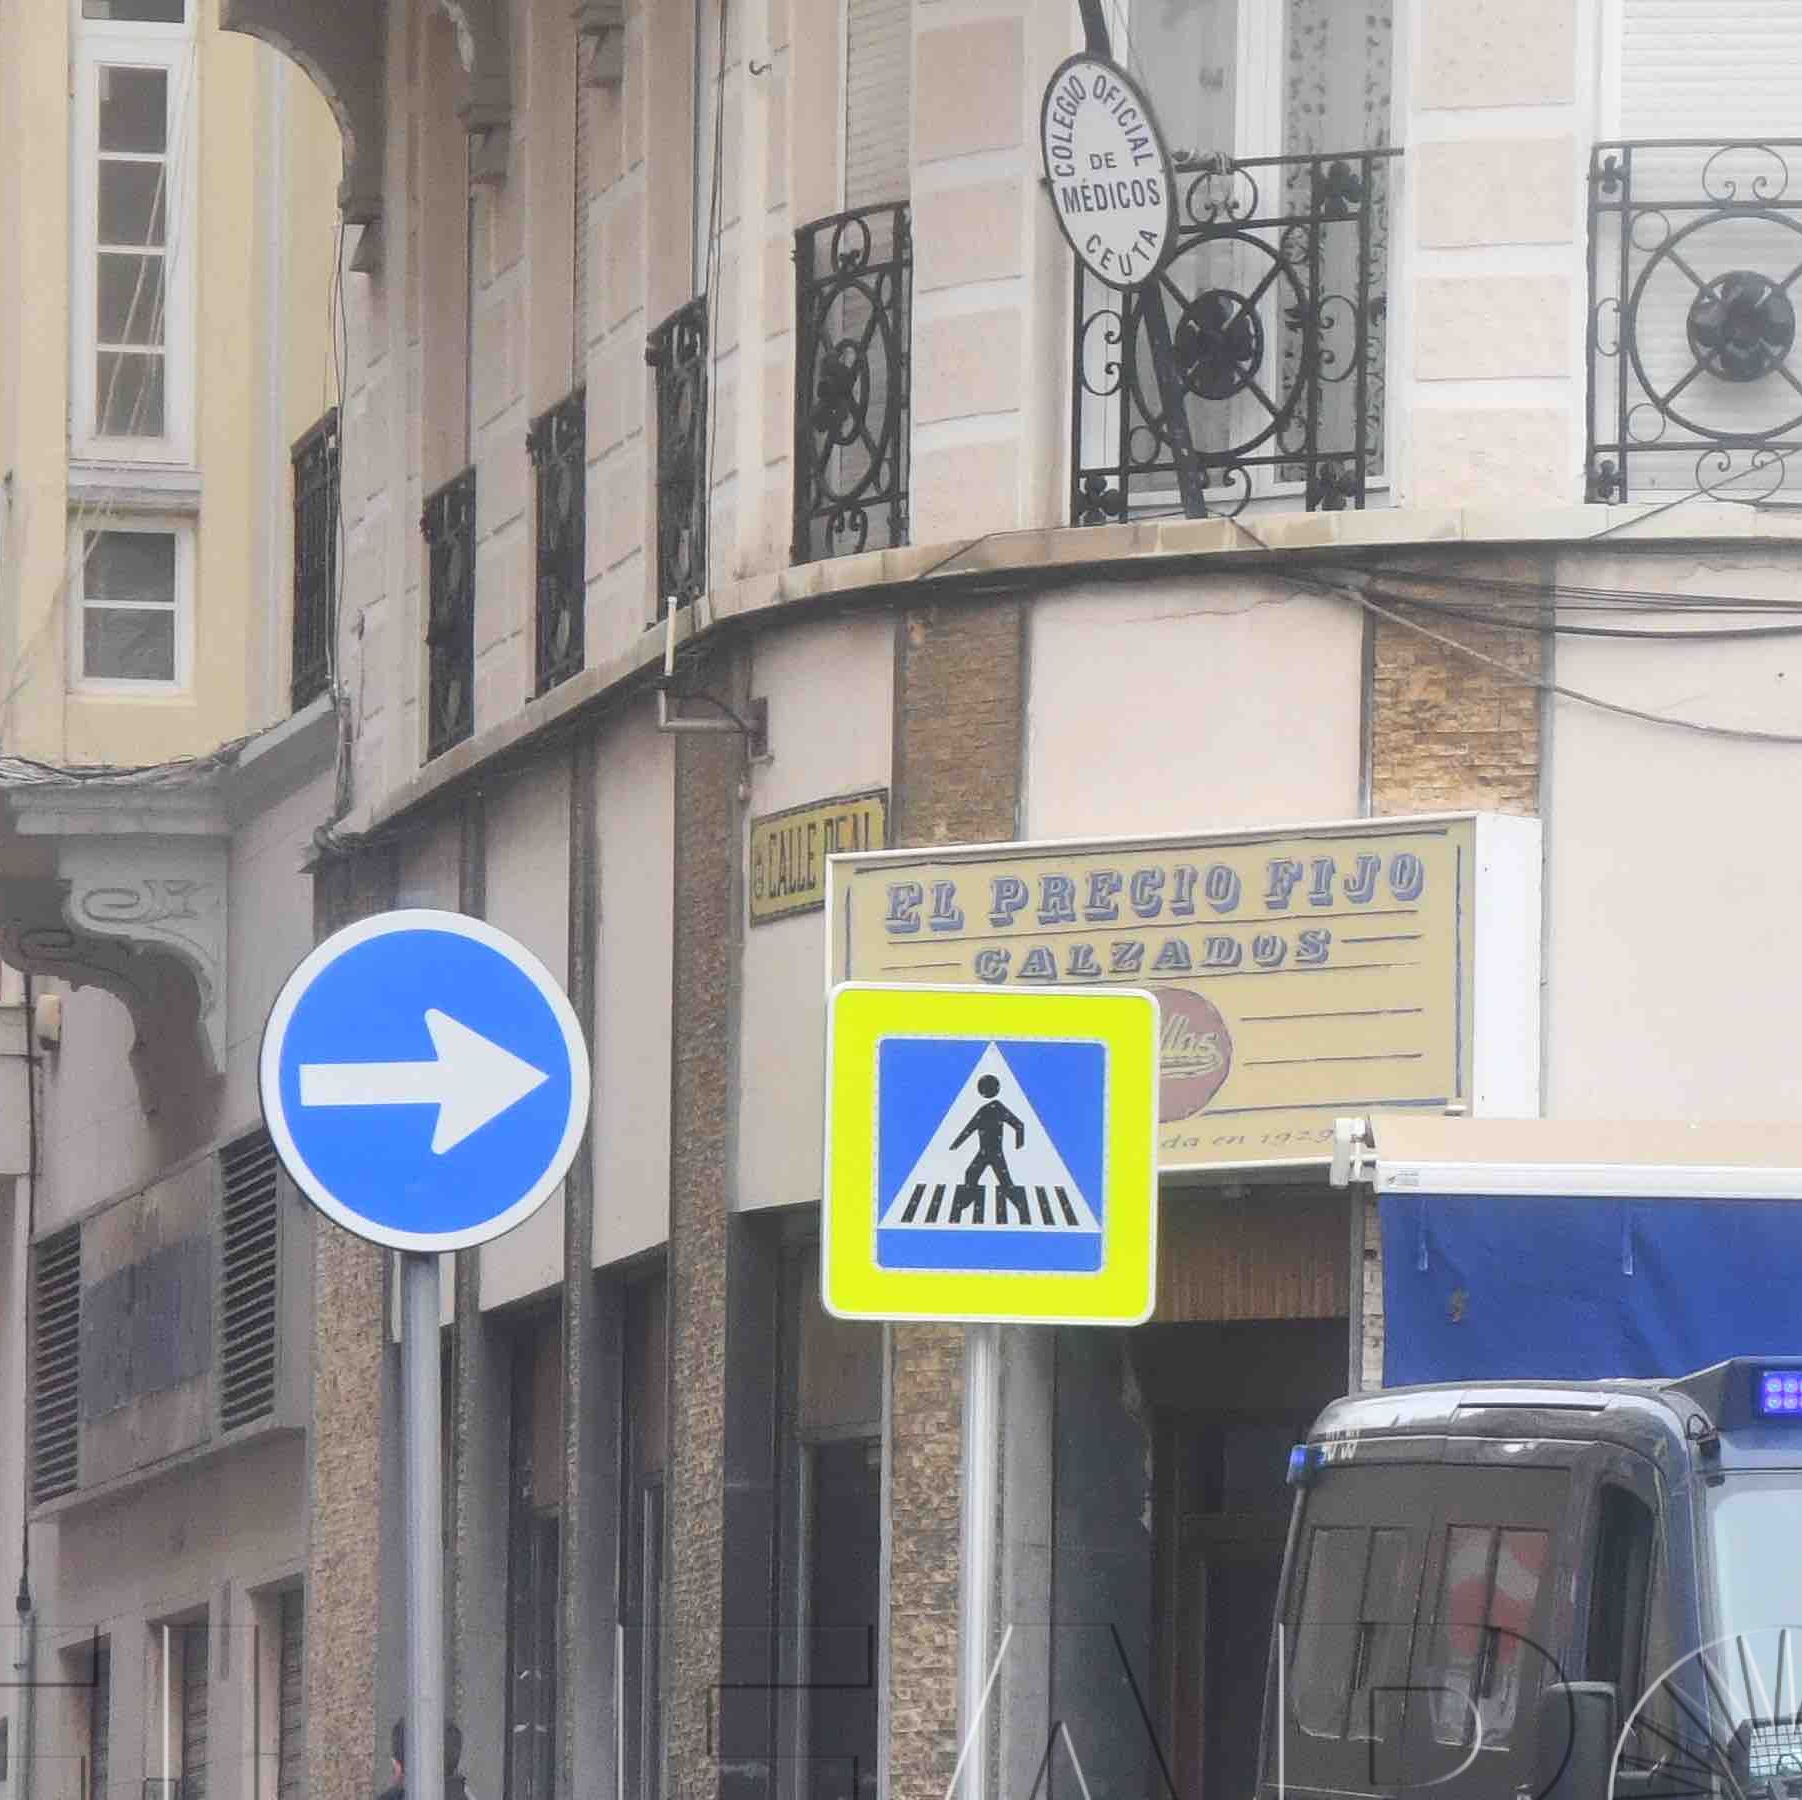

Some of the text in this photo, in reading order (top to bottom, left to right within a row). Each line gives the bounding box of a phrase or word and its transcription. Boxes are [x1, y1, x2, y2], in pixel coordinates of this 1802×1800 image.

[1052, 75, 1154, 177] COLEGIO OFICIAL
[1089, 152, 1117, 170] DE
[1061, 177, 1161, 214] MÉDICOS
[1086, 229, 1158, 276] CEUTA
[768, 822, 816, 898] CALLE
[884, 850, 1424, 933] EL PRECIO FIJO
[973, 927, 1331, 985] CALZADOS
[1158, 1133, 1200, 1150] da
